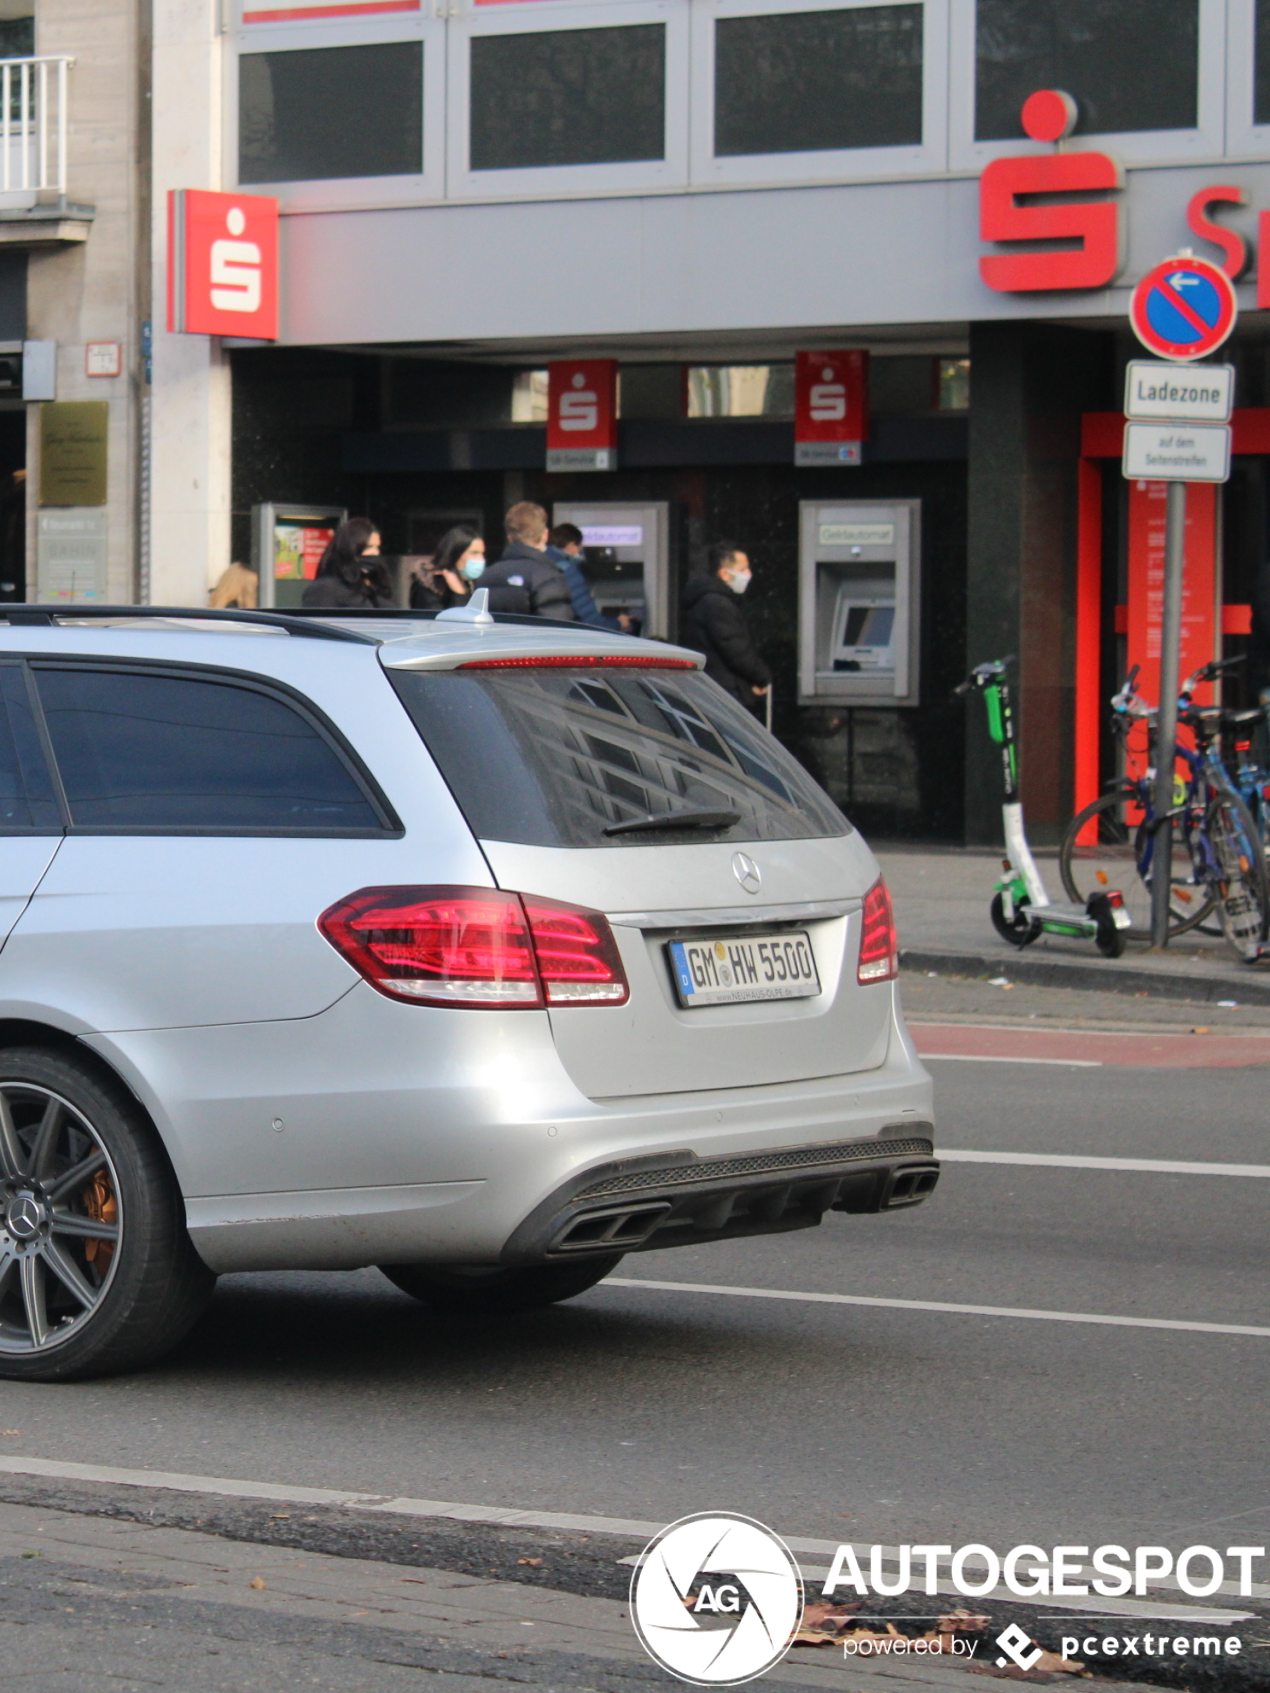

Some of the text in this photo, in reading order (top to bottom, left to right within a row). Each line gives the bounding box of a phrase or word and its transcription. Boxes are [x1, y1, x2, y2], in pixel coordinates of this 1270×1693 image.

[1187, 185, 1270, 309] S
[1138, 381, 1221, 403] Ladezone
[1159, 437, 1195, 450] auf dem
[1146, 454, 1207, 467] Seitenstreifen
[688, 947, 720, 988] GM
[728, 944, 759, 985] HW
[757, 941, 812, 981] 5500
